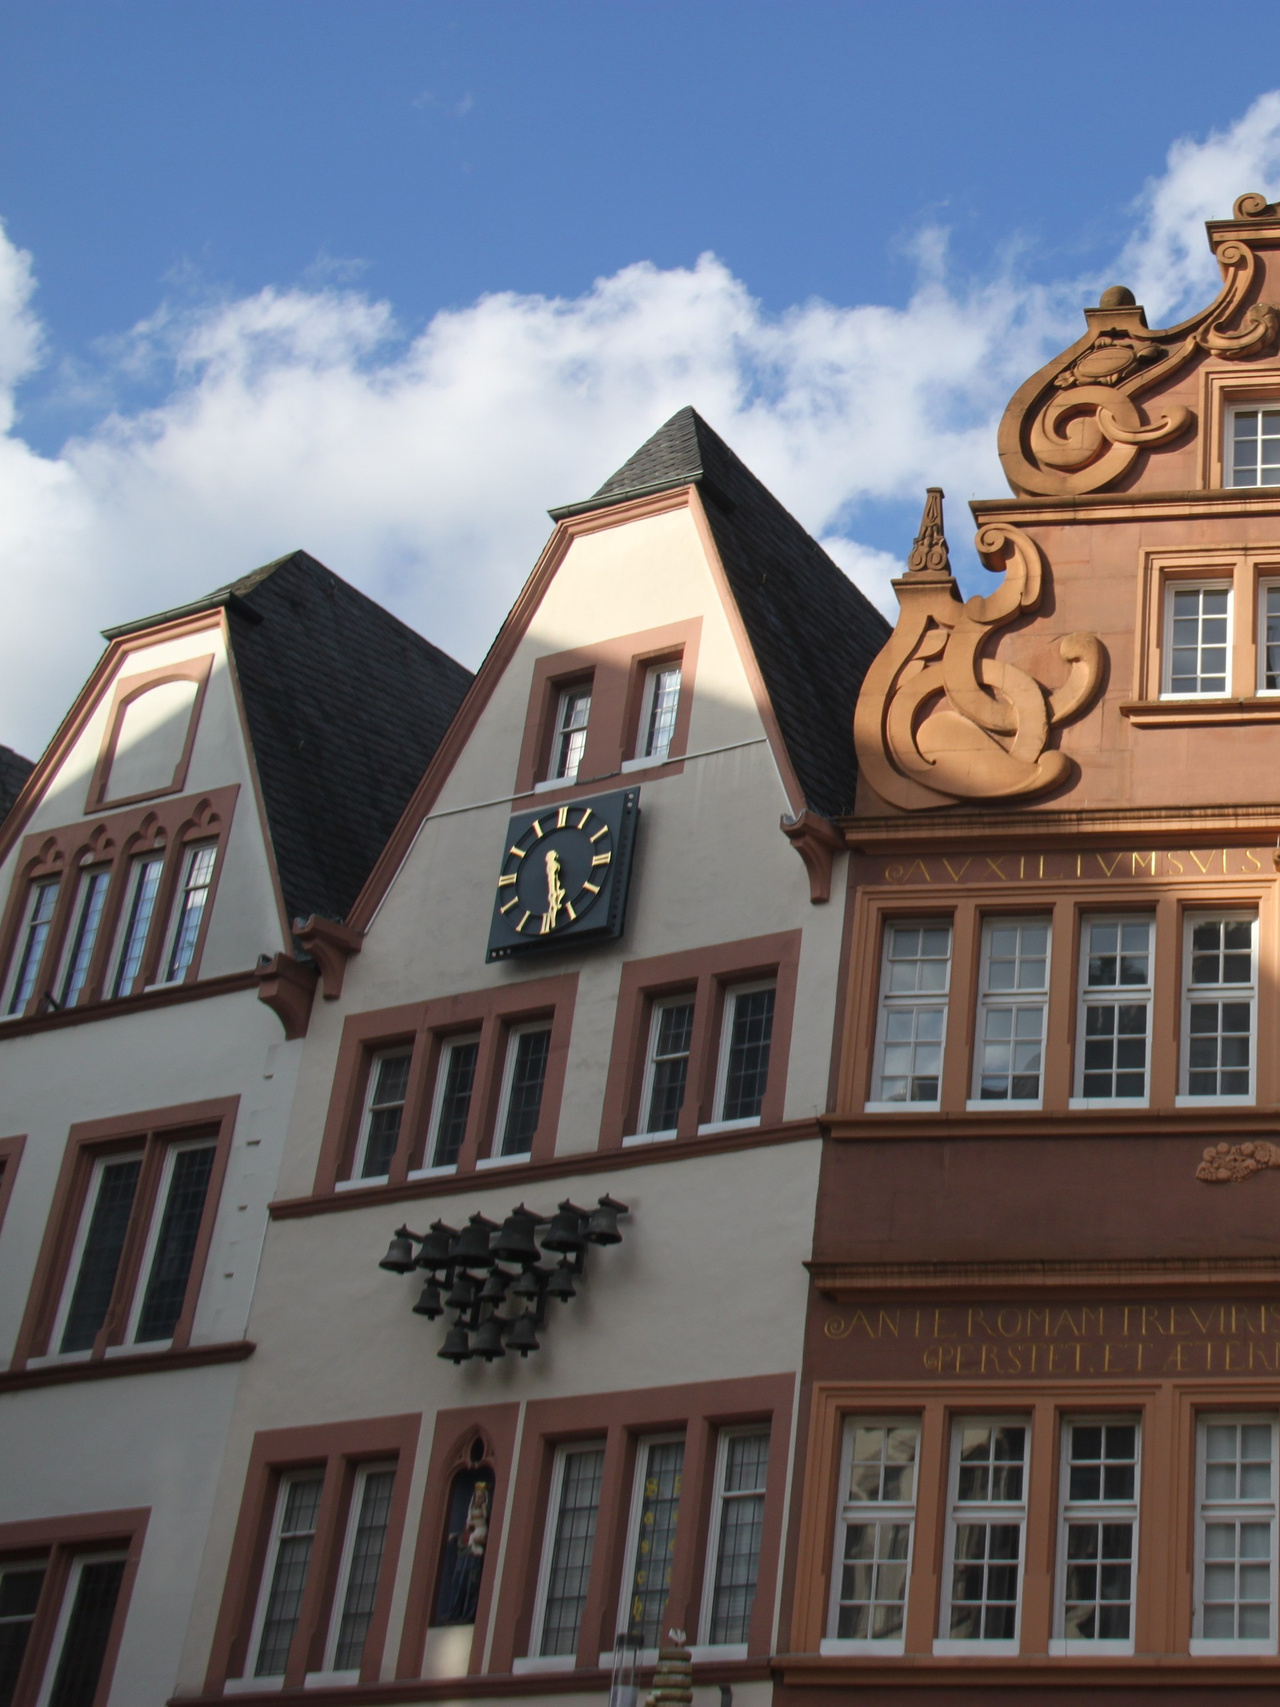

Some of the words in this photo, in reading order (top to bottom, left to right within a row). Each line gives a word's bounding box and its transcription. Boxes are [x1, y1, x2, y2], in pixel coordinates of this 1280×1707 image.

[886, 851, 1156, 884] AVXILIVM
[1166, 848, 1262, 876] SVIS
[824, 1308, 957, 1339] ANTE
[967, 1307, 1104, 1338] ROMAM
[1103, 1341, 1153, 1373] ET
